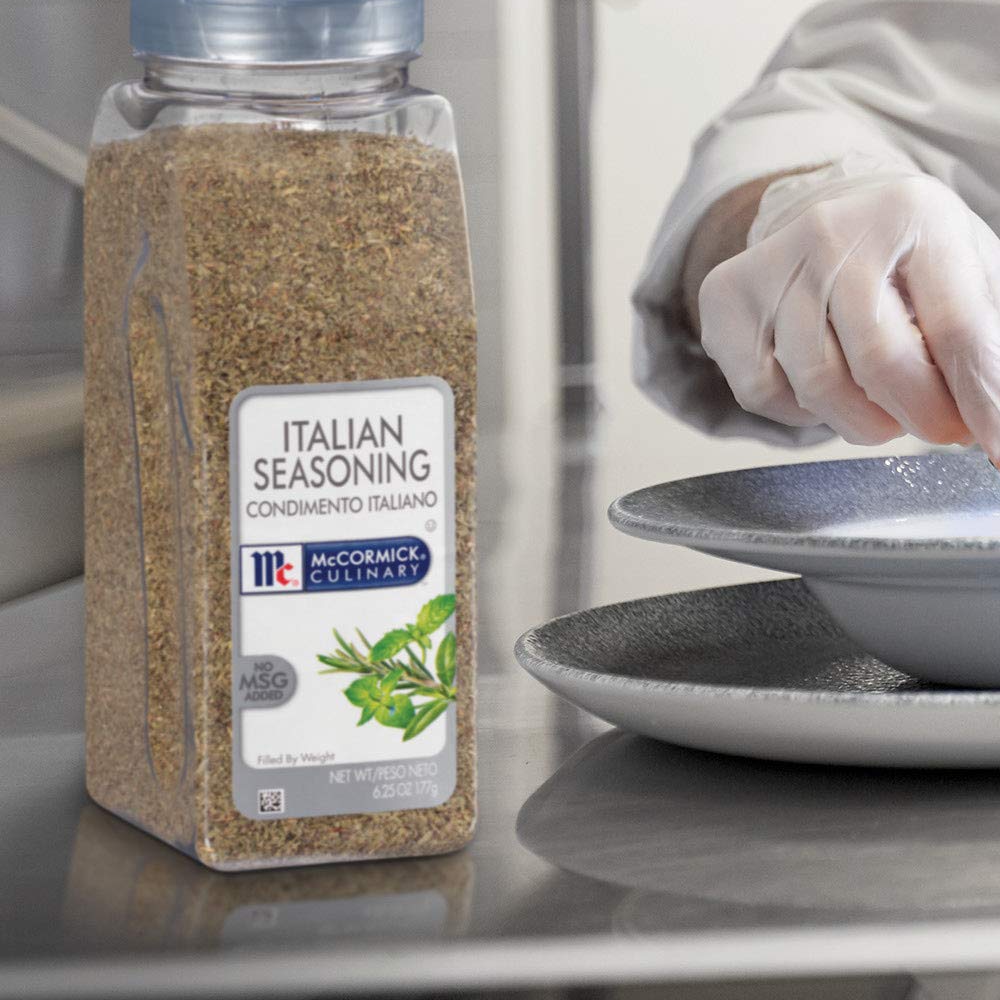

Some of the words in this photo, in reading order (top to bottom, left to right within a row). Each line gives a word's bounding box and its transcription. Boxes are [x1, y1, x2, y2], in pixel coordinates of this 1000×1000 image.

[283, 414, 403, 452] ITALIAN
[253, 449, 431, 491] SEASONING
[246, 496, 363, 518] CONDIMENTO
[368, 490, 438, 512] ITALIANO
[310, 564, 420, 583] CULINARY
[253, 661, 274, 672] NO
[239, 672, 289, 690] MSG
[244, 690, 284, 702] ADDED
[257, 754, 283, 765] Filled
[286, 753, 298, 767] By
[300, 751, 336, 764] Weight
[329, 769, 351, 784] NET
[408, 762, 438, 777] NETO
